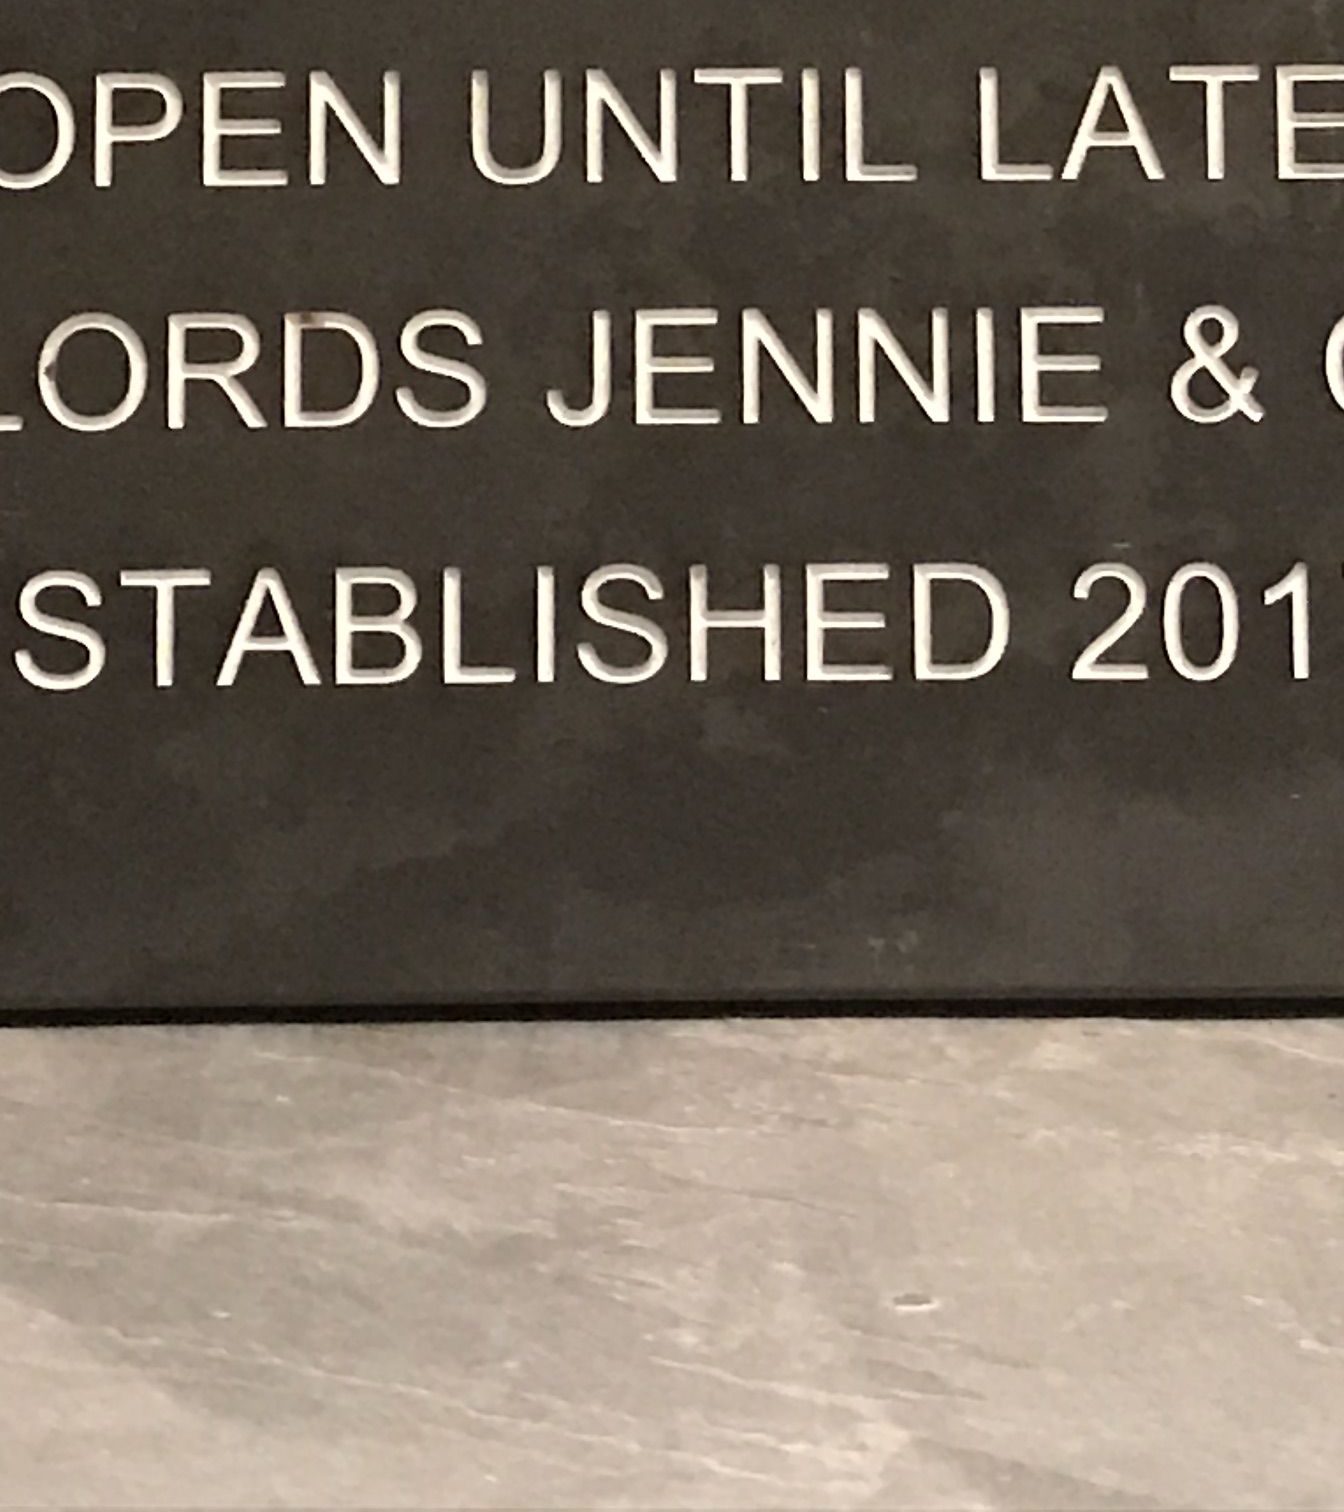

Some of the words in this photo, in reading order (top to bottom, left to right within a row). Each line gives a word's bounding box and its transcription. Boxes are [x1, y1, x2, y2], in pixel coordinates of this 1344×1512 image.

[469, 66, 919, 186] UNTIL
[544, 305, 1110, 430] JENNIE
[1168, 303, 1267, 426] &
